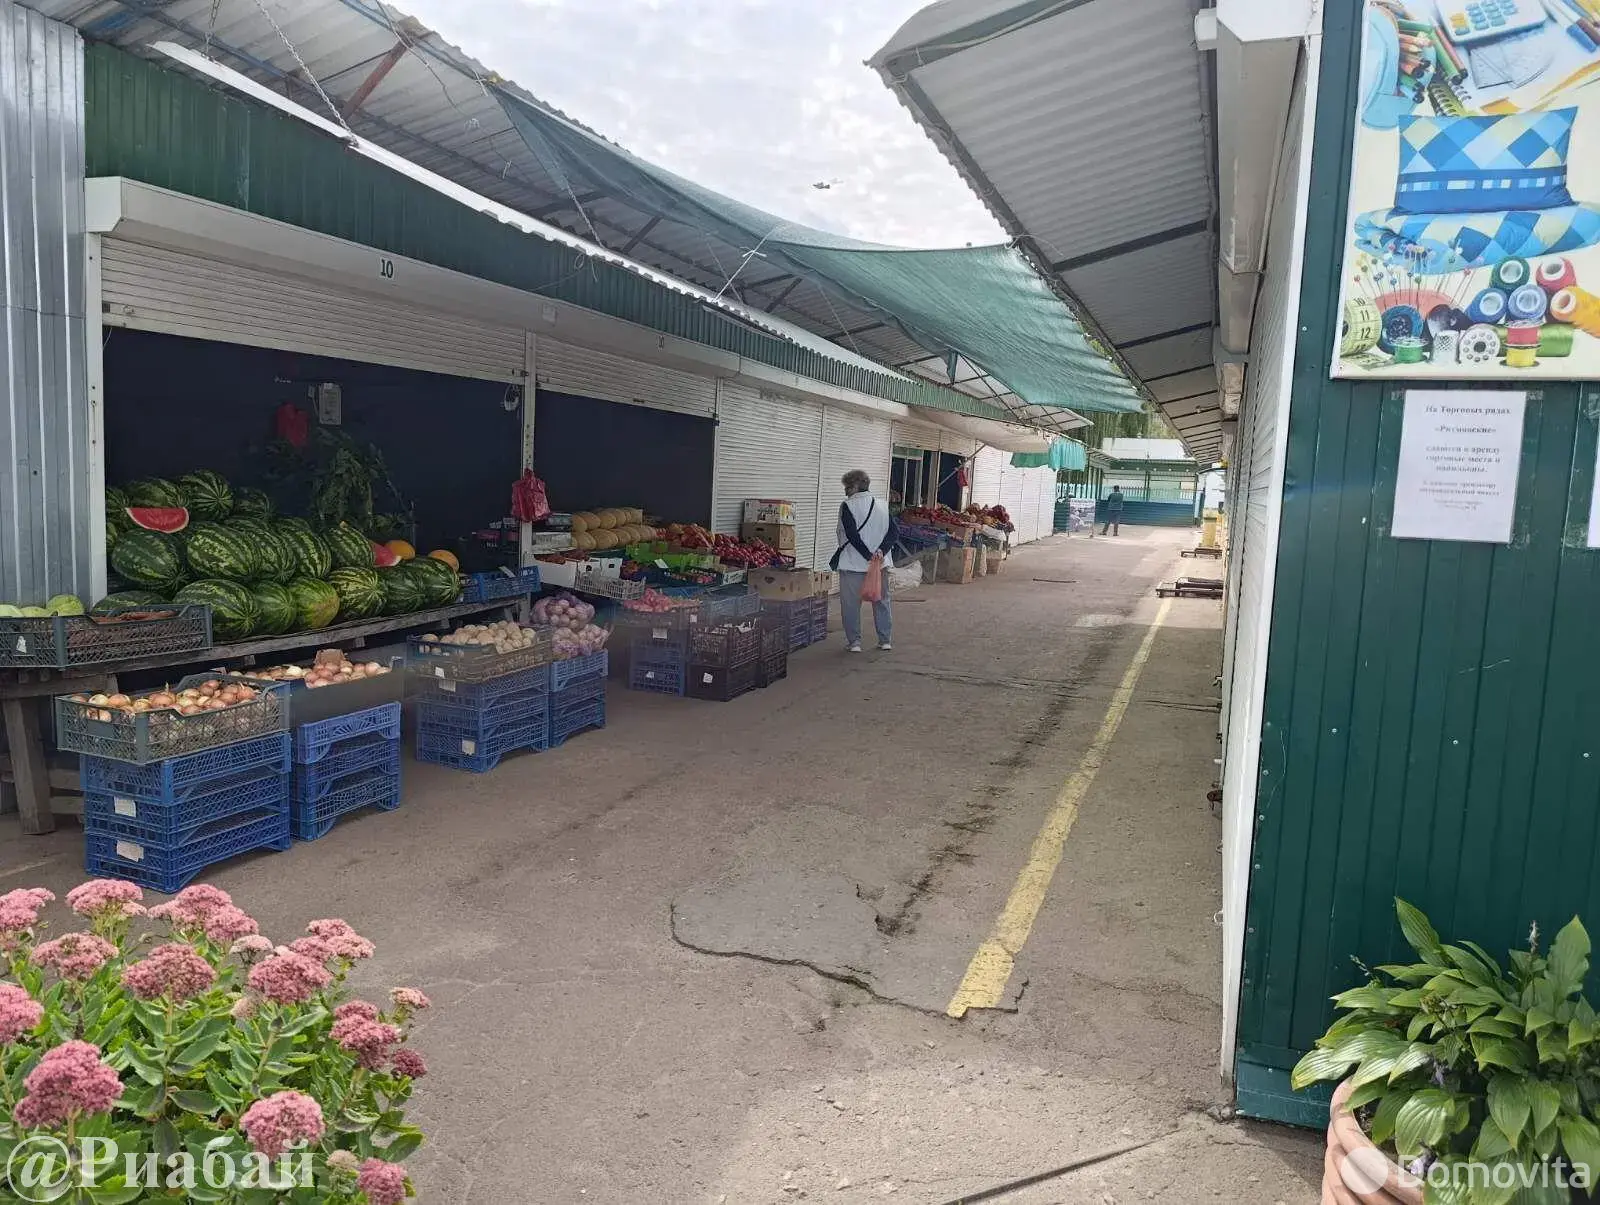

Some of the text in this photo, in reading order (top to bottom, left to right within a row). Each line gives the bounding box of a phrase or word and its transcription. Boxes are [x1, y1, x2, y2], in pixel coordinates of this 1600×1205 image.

[381, 259, 393, 278] 10
[1360, 310, 1370, 321] 11
[1361, 326, 1371, 340] 12
